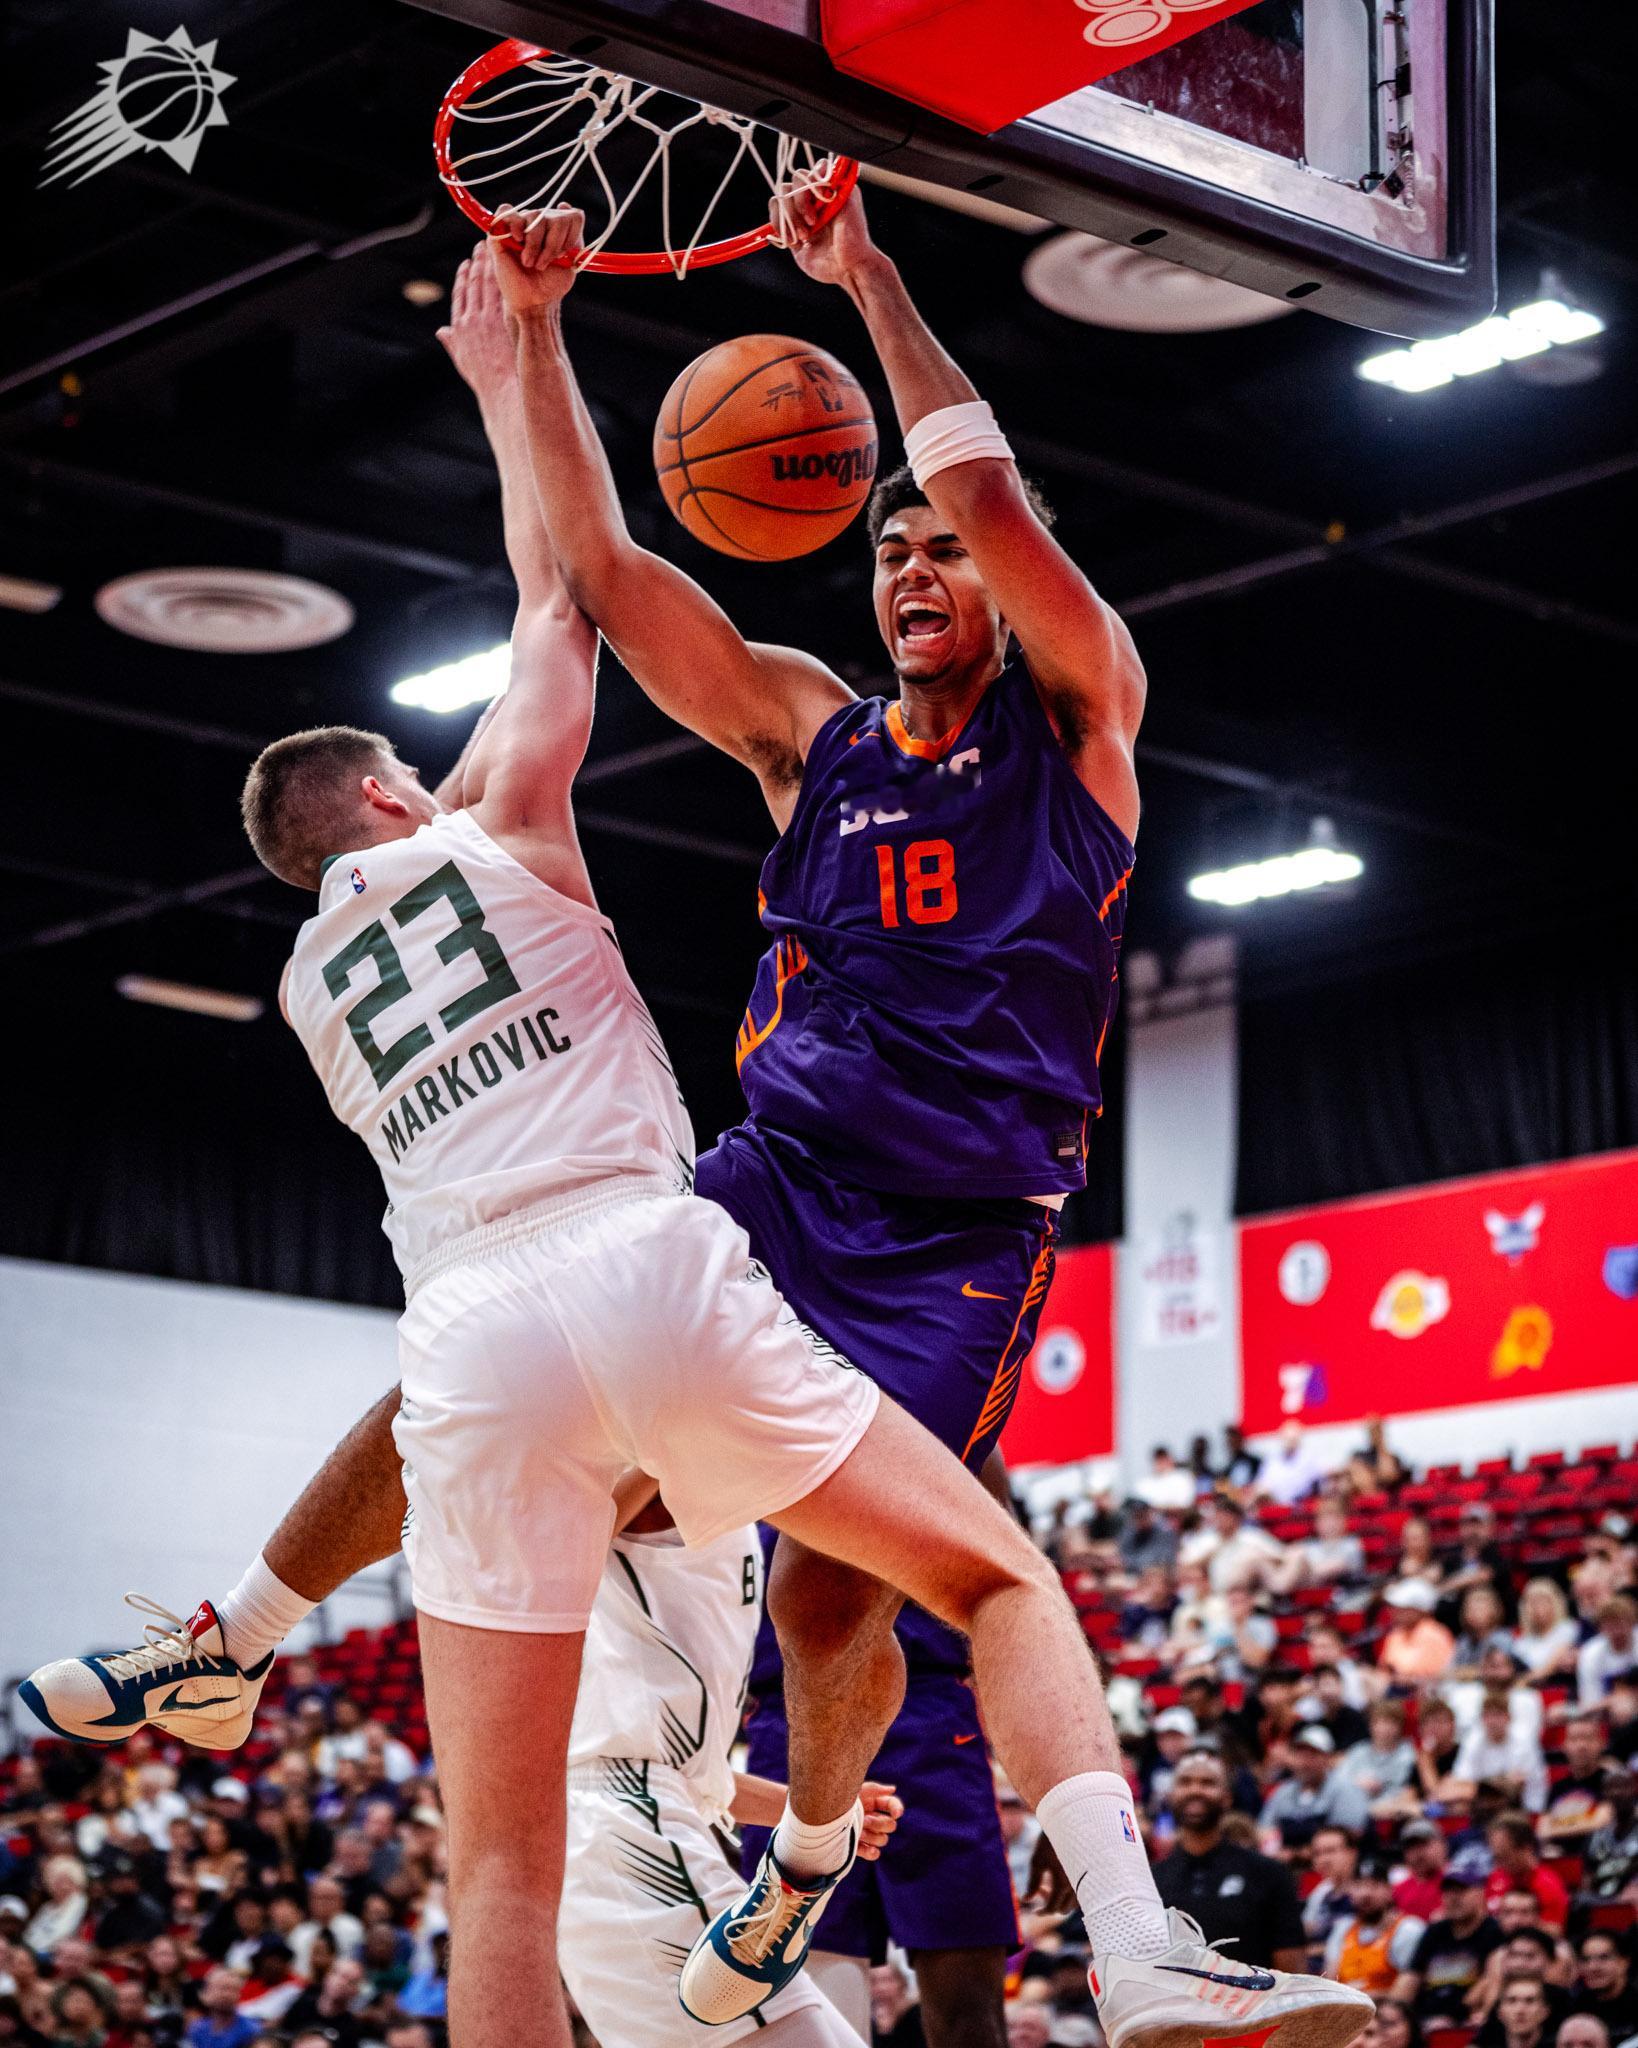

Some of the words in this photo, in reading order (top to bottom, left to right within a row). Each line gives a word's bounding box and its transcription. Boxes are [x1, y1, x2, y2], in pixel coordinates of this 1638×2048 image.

[874, 838, 959, 929] 18
[321, 859, 522, 1092] 23
[381, 1007, 572, 1166] MARKOVIC
